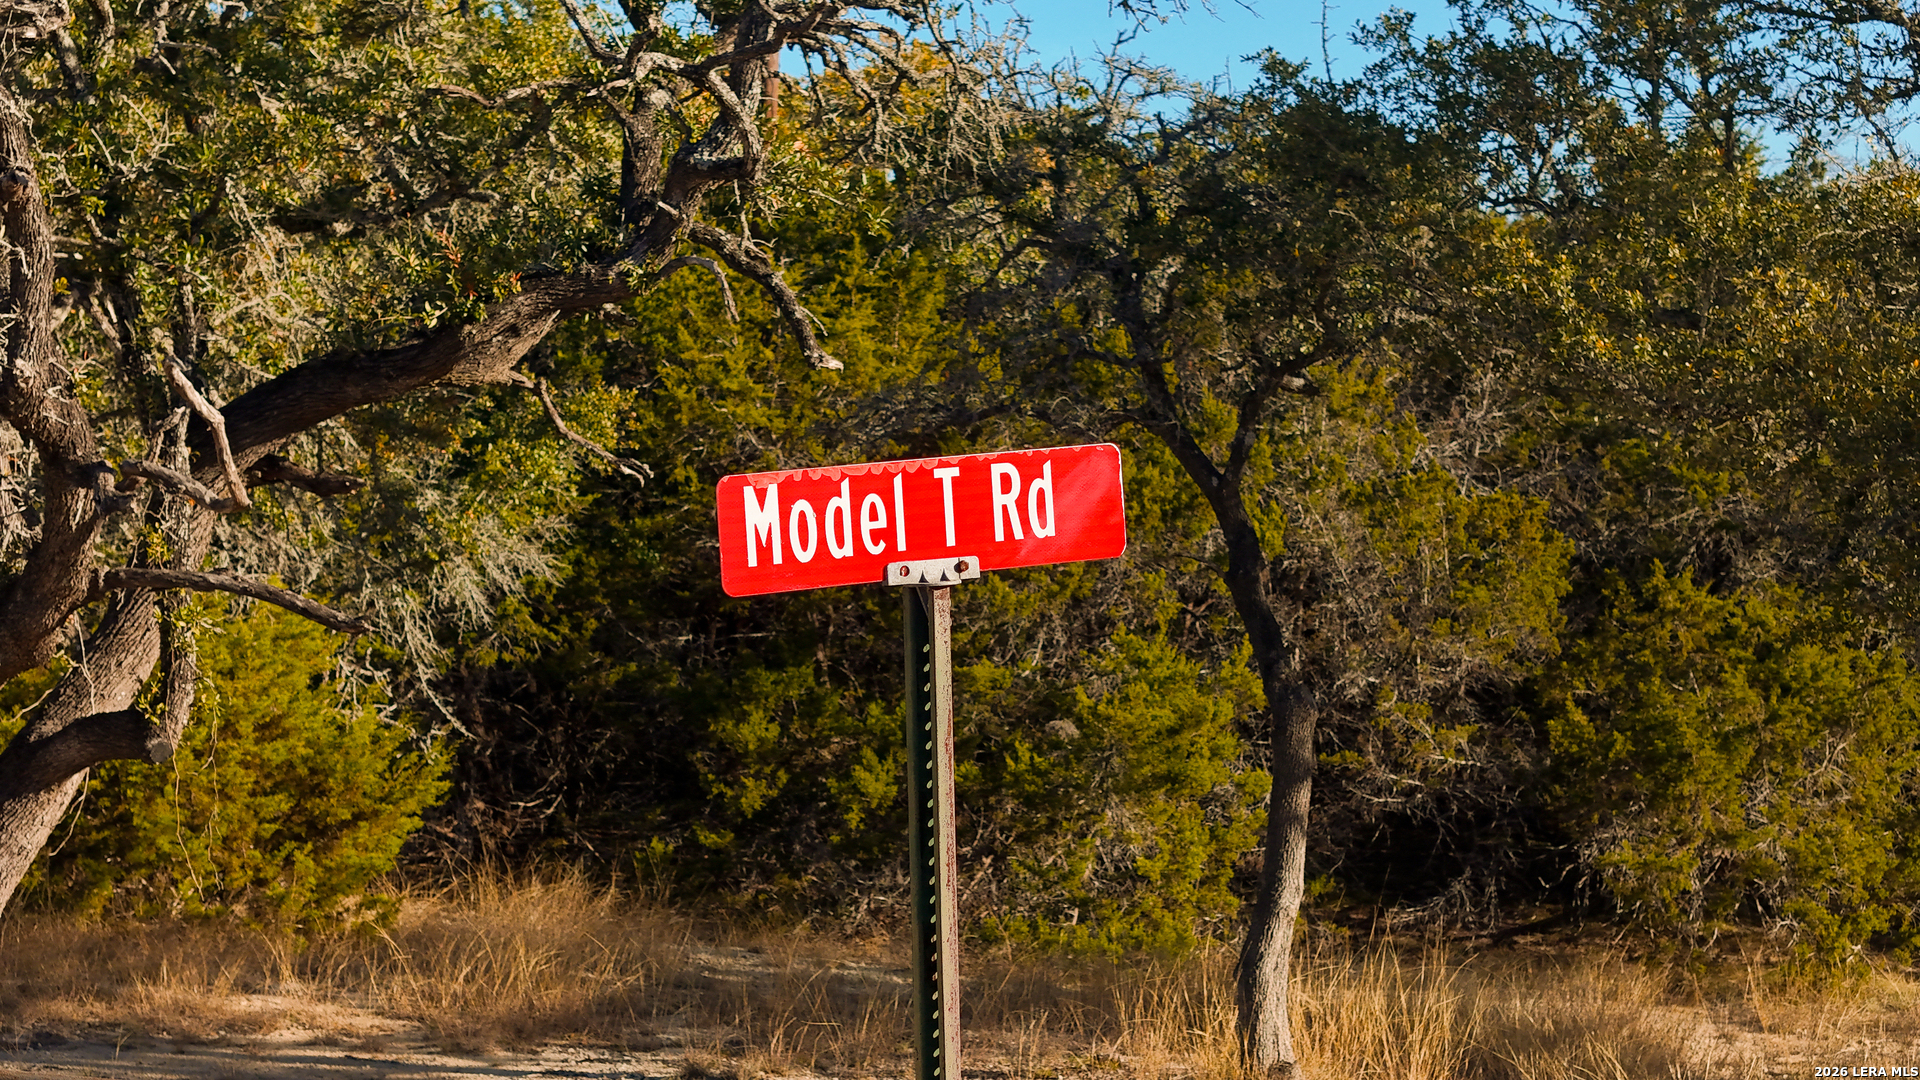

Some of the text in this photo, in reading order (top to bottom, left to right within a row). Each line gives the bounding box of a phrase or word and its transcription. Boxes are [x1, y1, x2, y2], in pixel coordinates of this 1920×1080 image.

[743, 459, 1056, 568] Model T Rd
